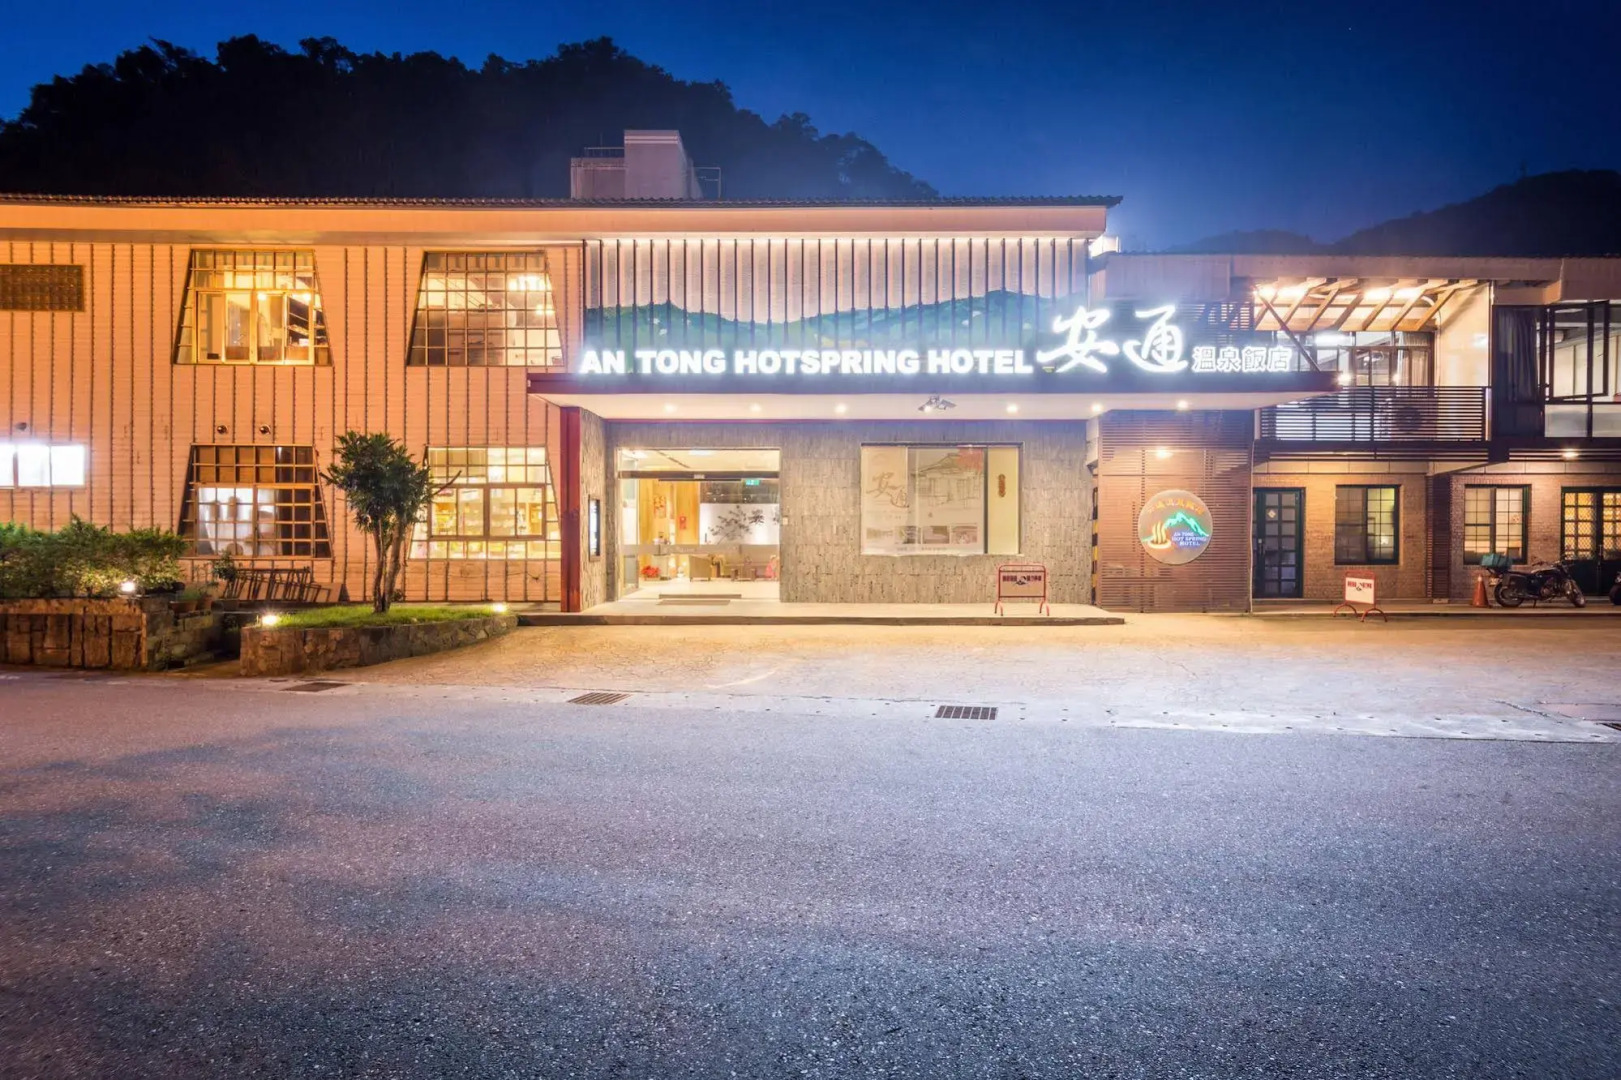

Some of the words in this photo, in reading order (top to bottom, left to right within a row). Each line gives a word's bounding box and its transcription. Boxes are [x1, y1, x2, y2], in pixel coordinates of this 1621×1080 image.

[579, 349, 626, 374] AN
[635, 349, 726, 374] TONG
[734, 349, 920, 374] HOTSPRING
[927, 349, 1034, 374] HOTEL
[1037, 304, 1189, 374] 安通
[1192, 345, 1293, 374] 溫泉飯店
